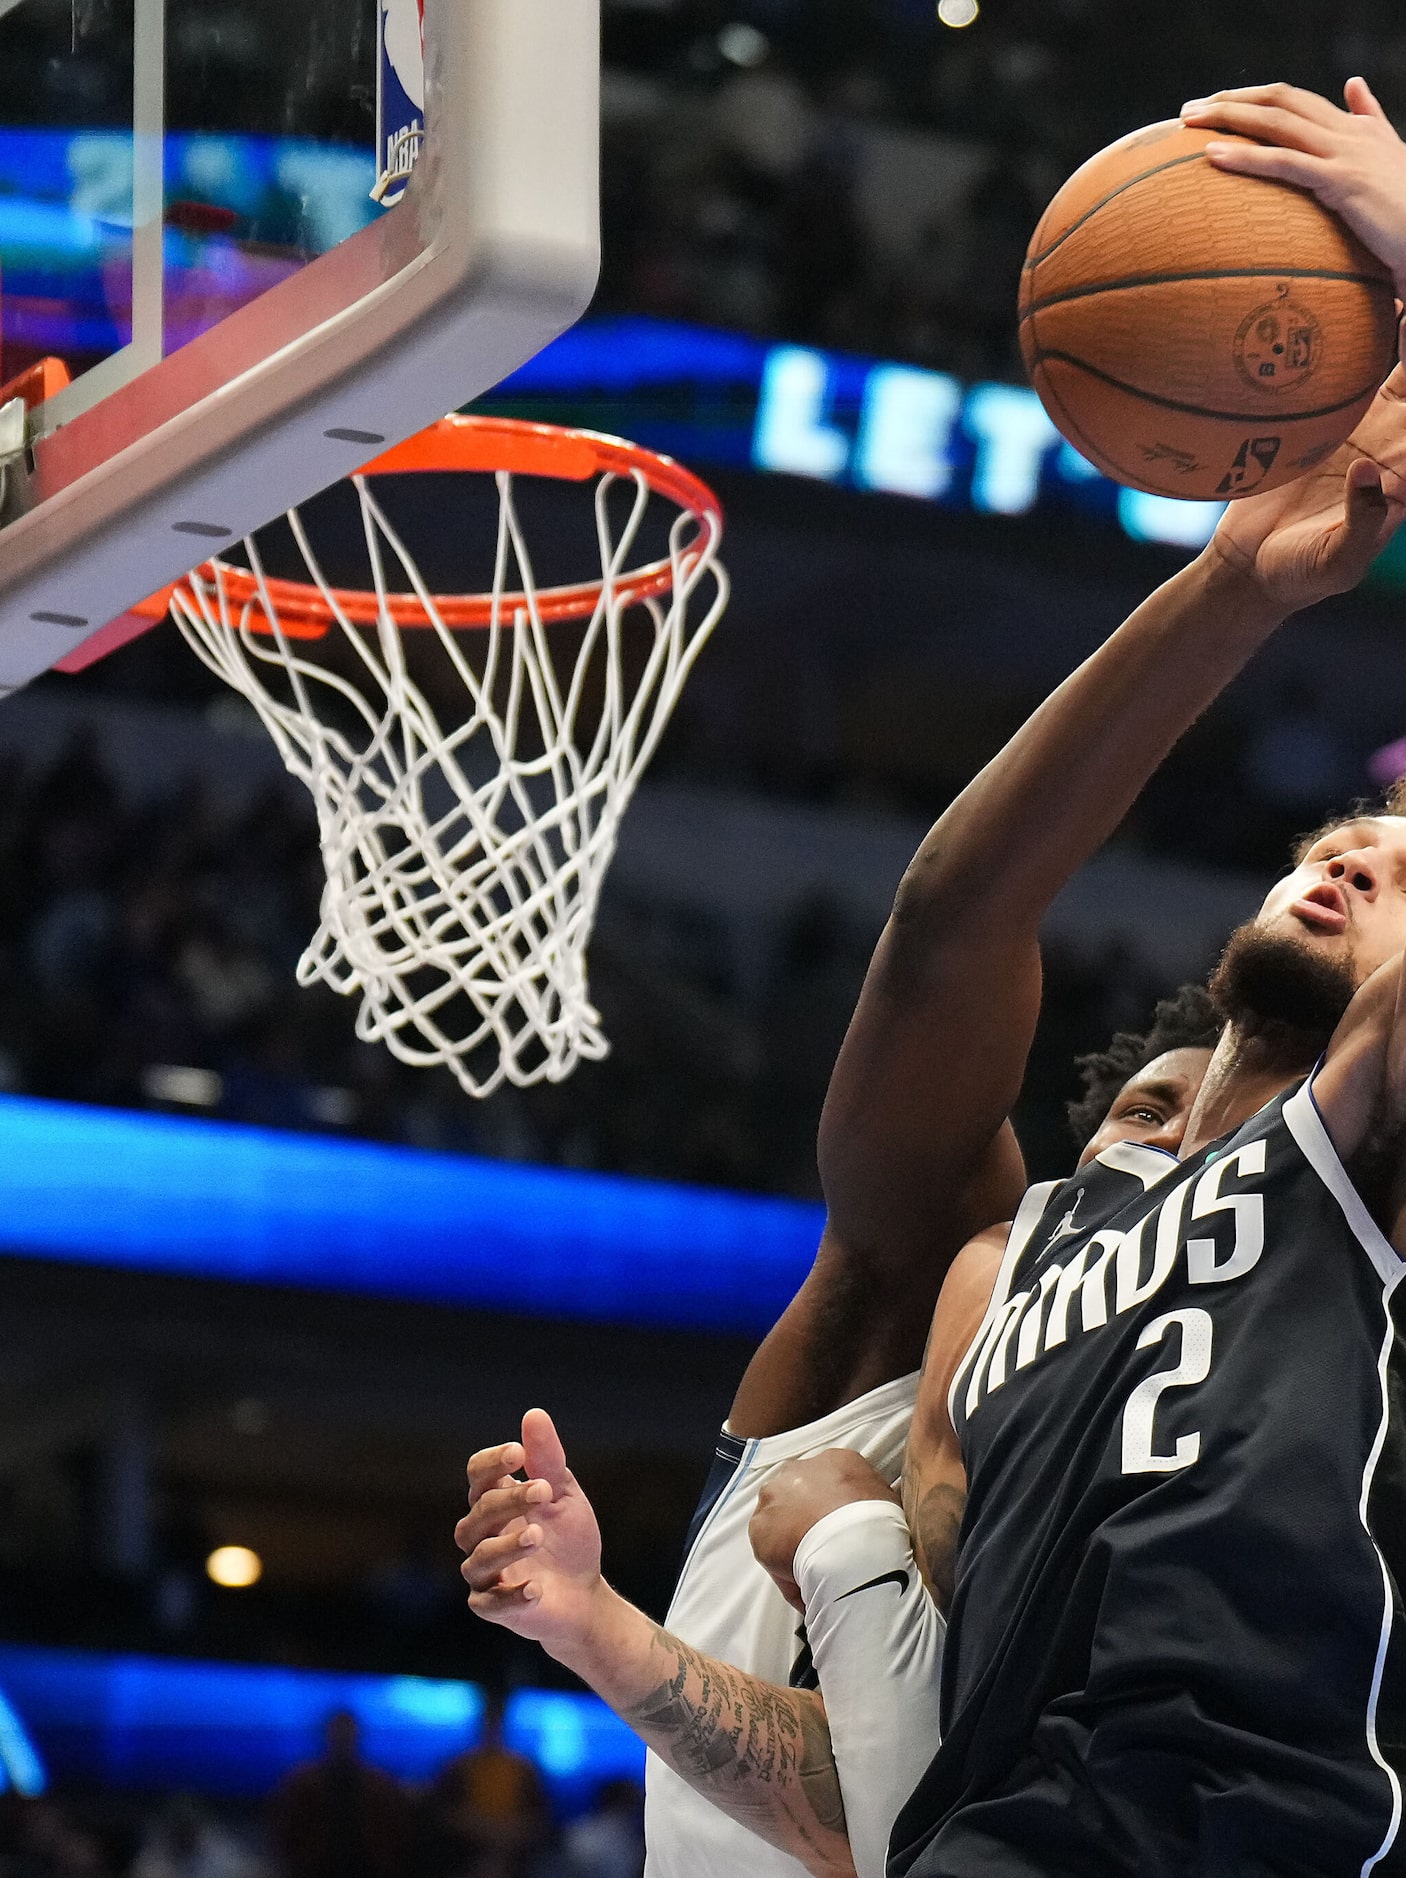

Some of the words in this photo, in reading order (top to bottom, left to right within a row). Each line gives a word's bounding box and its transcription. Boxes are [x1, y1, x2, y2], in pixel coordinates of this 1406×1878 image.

[387, 119, 418, 175] NBA
[965, 1138, 1267, 1421] MAVS
[1122, 1307, 1213, 1475] 2
